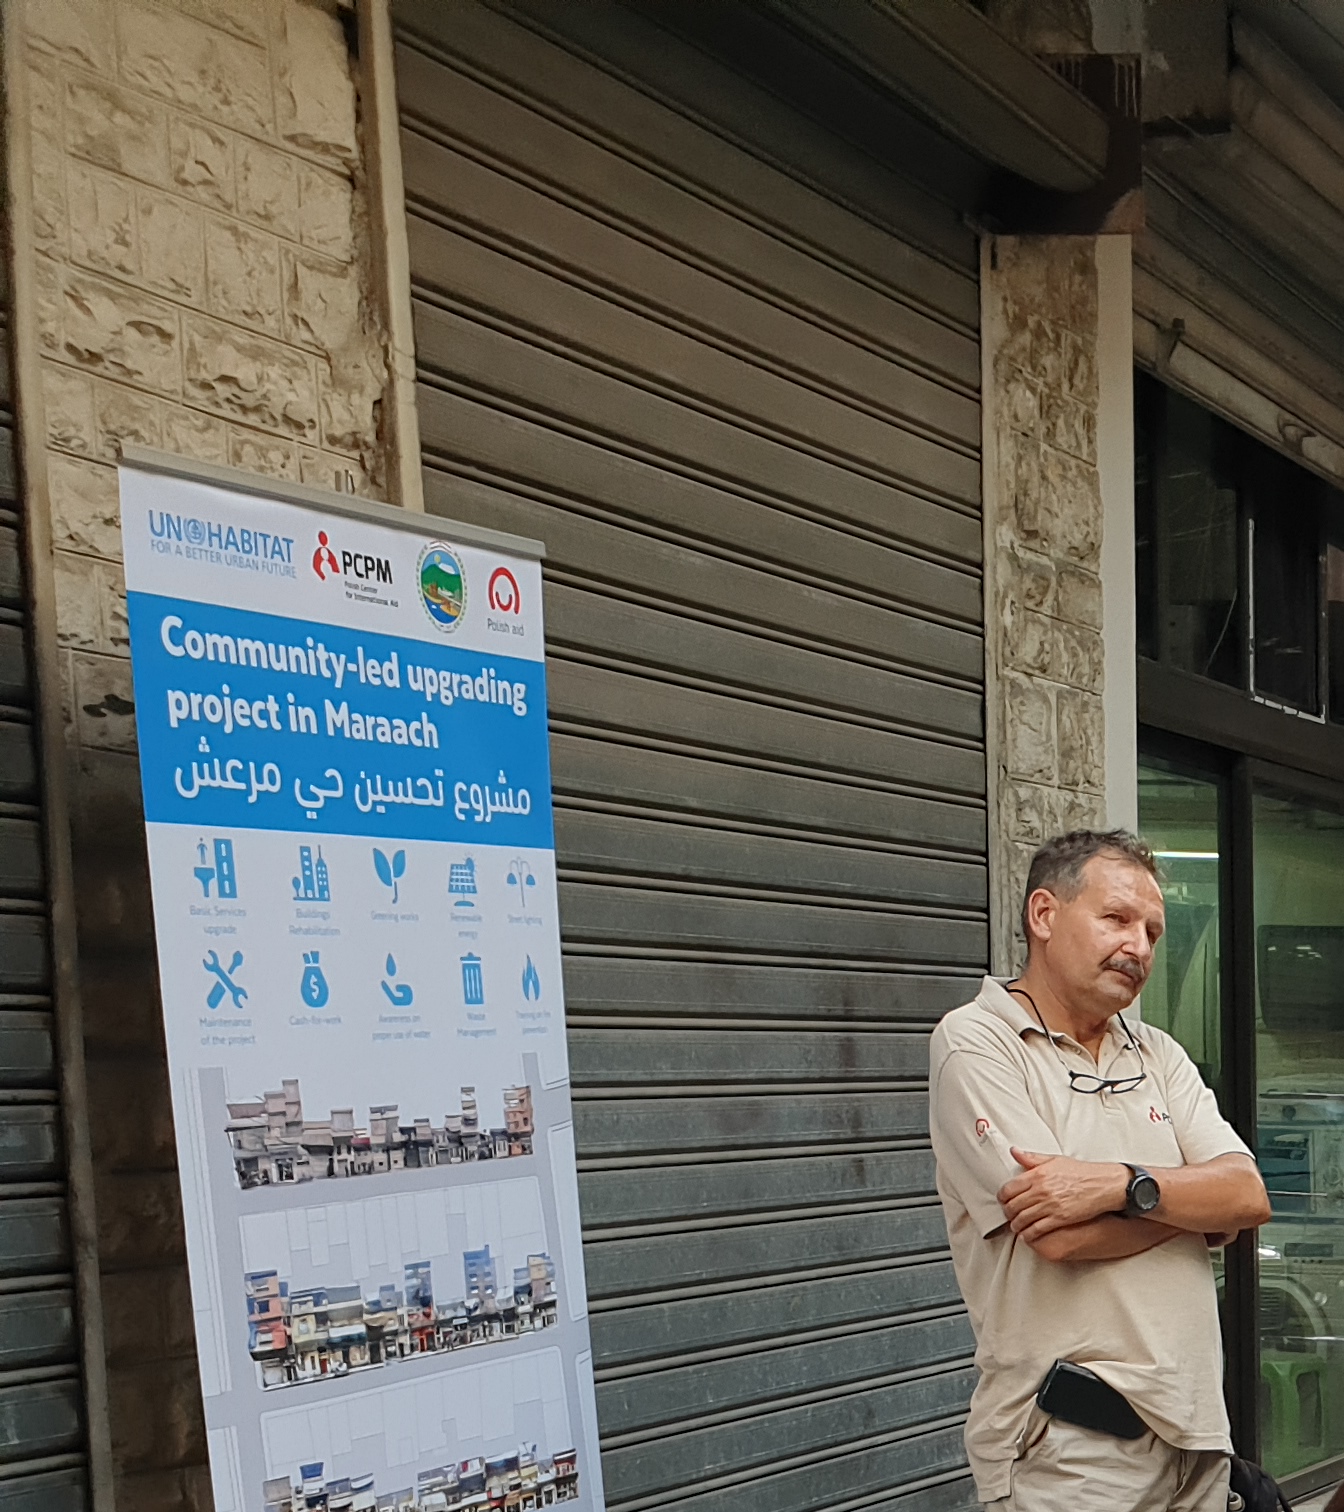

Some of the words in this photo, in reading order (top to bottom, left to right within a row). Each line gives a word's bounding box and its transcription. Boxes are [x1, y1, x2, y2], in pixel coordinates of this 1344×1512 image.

[151, 539, 174, 554] FOR
[175, 544, 183, 556] A
[185, 545, 222, 565] BETTER
[224, 554, 259, 571] URBAN
[261, 562, 297, 578] FUTURE
[342, 551, 393, 584] PCPM
[487, 618, 510, 634] Polish
[512, 623, 525, 636] aid
[161, 615, 400, 688] Community-led
[408, 661, 527, 716] upgrading
[167, 684, 279, 733] project
[287, 693, 318, 734] in
[327, 699, 439, 748] Maraach
[175, 736, 281, 803] مرعش
[294, 768, 344, 818] حي
[354, 769, 444, 814] تحسين
[454, 769, 531, 822] مشروع
